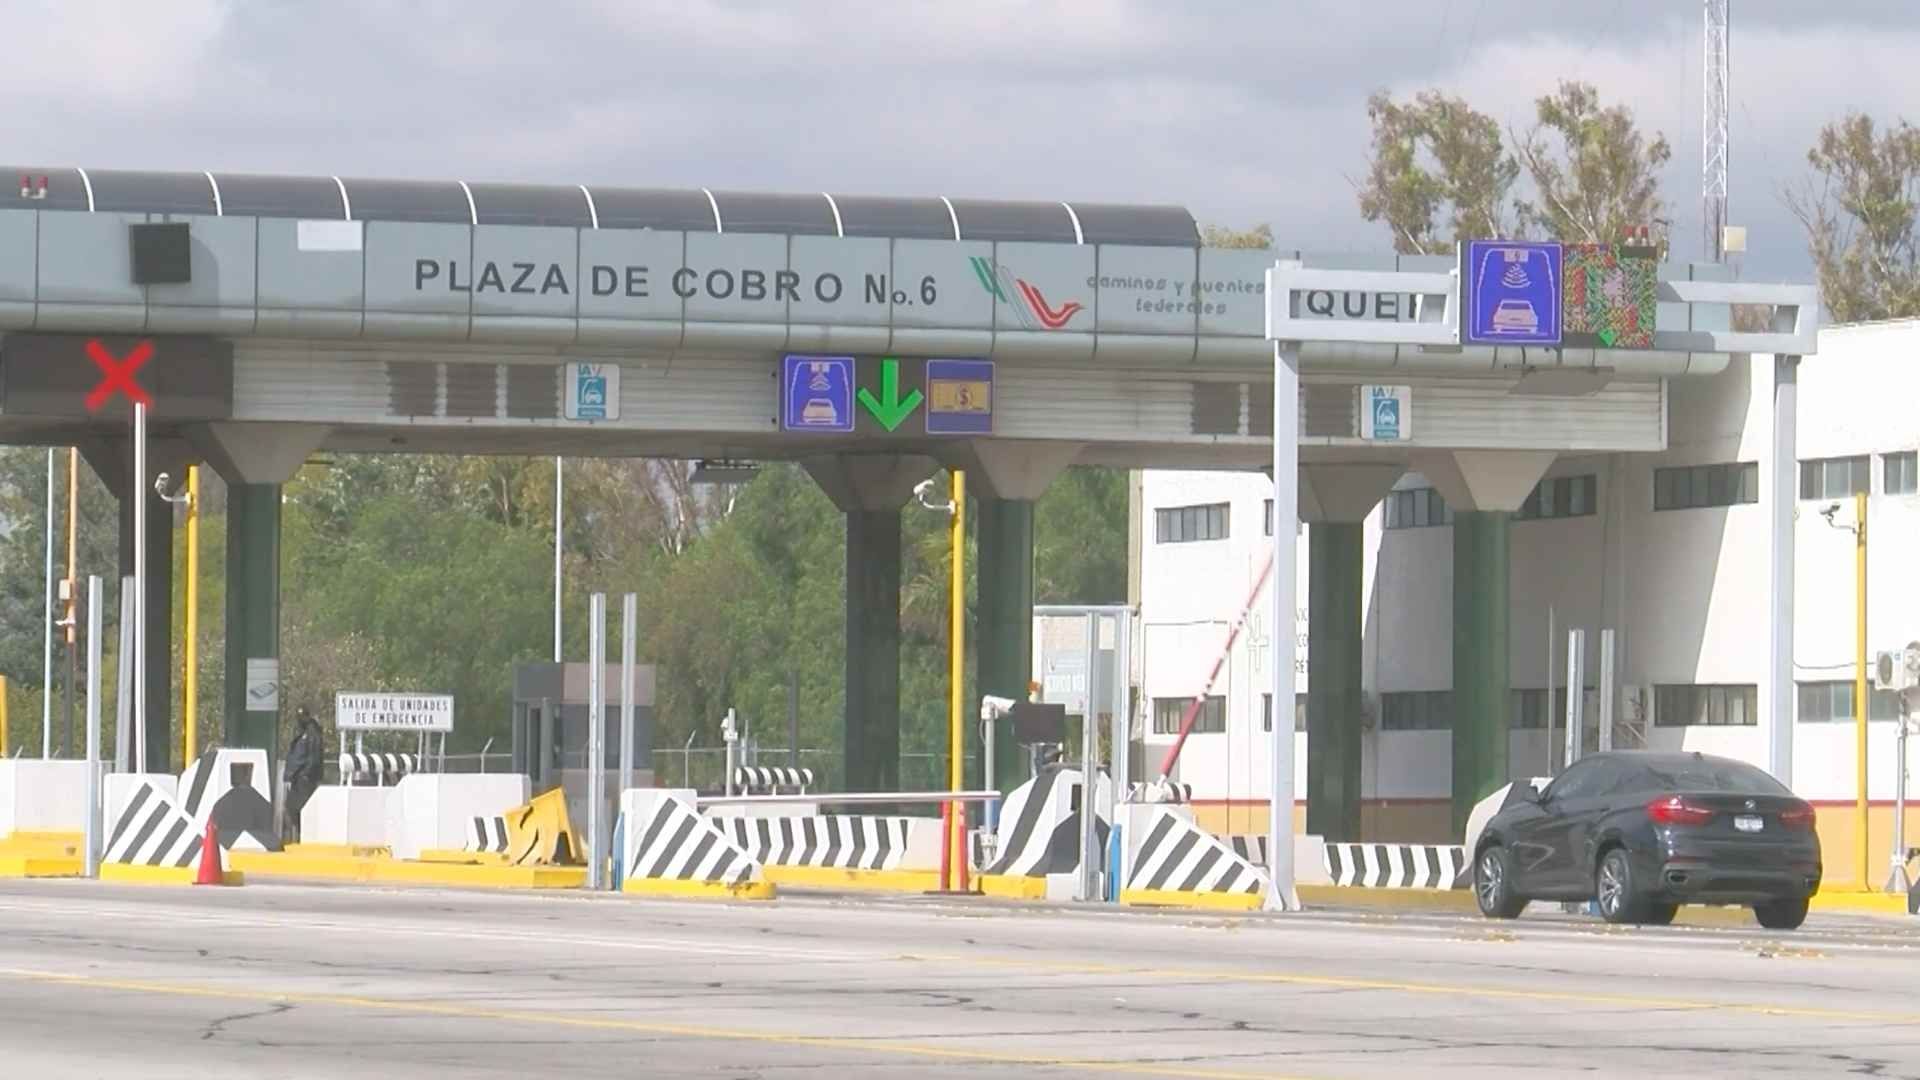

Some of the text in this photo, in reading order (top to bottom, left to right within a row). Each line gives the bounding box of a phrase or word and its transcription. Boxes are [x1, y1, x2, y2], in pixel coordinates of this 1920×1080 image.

[414, 258, 570, 296] PLAZA
[591, 265, 650, 298] DE
[672, 267, 844, 303] COBRO
[1086, 275, 1167, 291] caminos
[1174, 281, 1185, 296] y
[341, 699, 448, 711] SALIDA DE UNIDADES
[355, 713, 434, 724] DE EMERGENCIA
